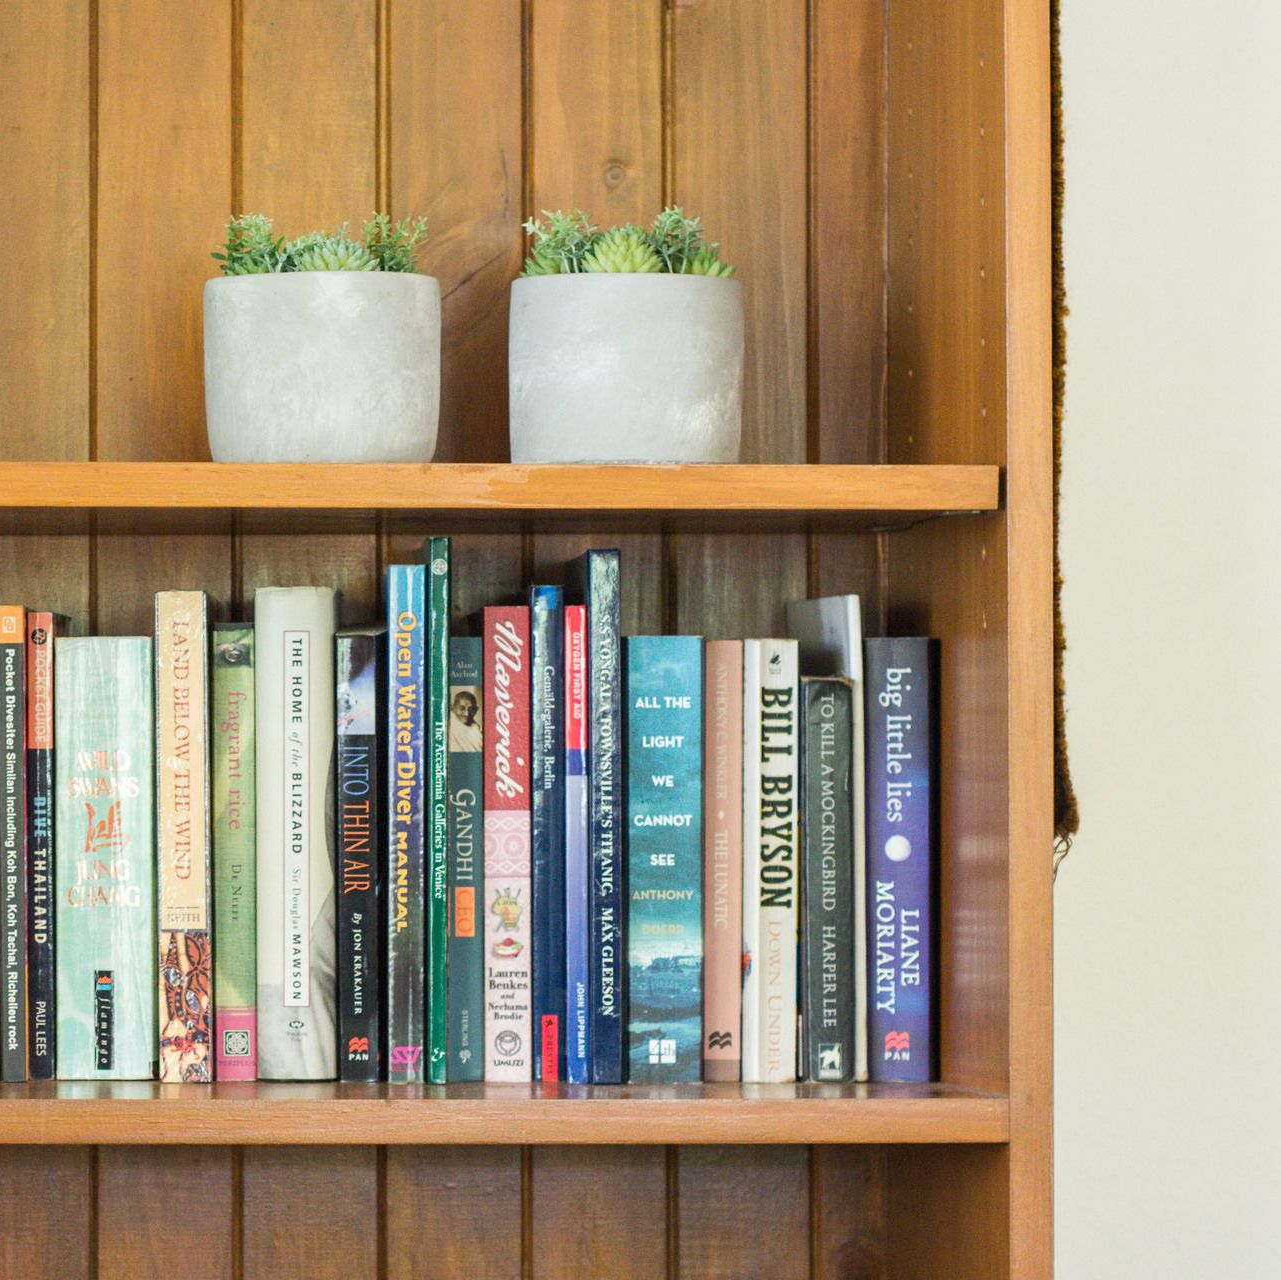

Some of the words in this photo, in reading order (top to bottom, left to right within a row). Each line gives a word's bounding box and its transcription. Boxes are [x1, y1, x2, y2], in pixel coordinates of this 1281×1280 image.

[5, 648, 16, 689] Pocket
[881, 667, 912, 707] big
[5, 693, 16, 750] Divesite:
[493, 620, 524, 799] Maverick
[635, 697, 663, 708] ALL
[668, 697, 691, 708] THE
[821, 693, 835, 719] TO
[642, 737, 684, 748] LIGHT
[760, 687, 792, 763] BILL
[821, 722, 835, 760] KILL
[886, 714, 911, 775] little
[6, 752, 17, 793] Similan
[343, 745, 370, 795] INTO
[651, 776, 674, 787] WE
[821, 763, 835, 777] A
[4, 796, 17, 847] including
[634, 815, 692, 827] CANNOT
[886, 781, 912, 822] lies
[343, 800, 370, 855] THIN
[760, 775, 792, 908] BRYSON
[821, 781, 836, 911] MOCKINGBIRD
[6, 850, 17, 873] Koh
[343, 859, 370, 894] AIR
[650, 855, 675, 866] SEE
[5, 876, 17, 901] Bon,
[7, 904, 17, 926] Koh
[5, 929, 18, 969] Tachai,
[823, 926, 836, 994] HARPER
[875, 881, 895, 1015] MORIARTY
[901, 909, 920, 986] LIANE
[7, 972, 18, 1022] Richelieu
[824, 998, 837, 1027] LEE
[7, 1025, 18, 1050] rock
